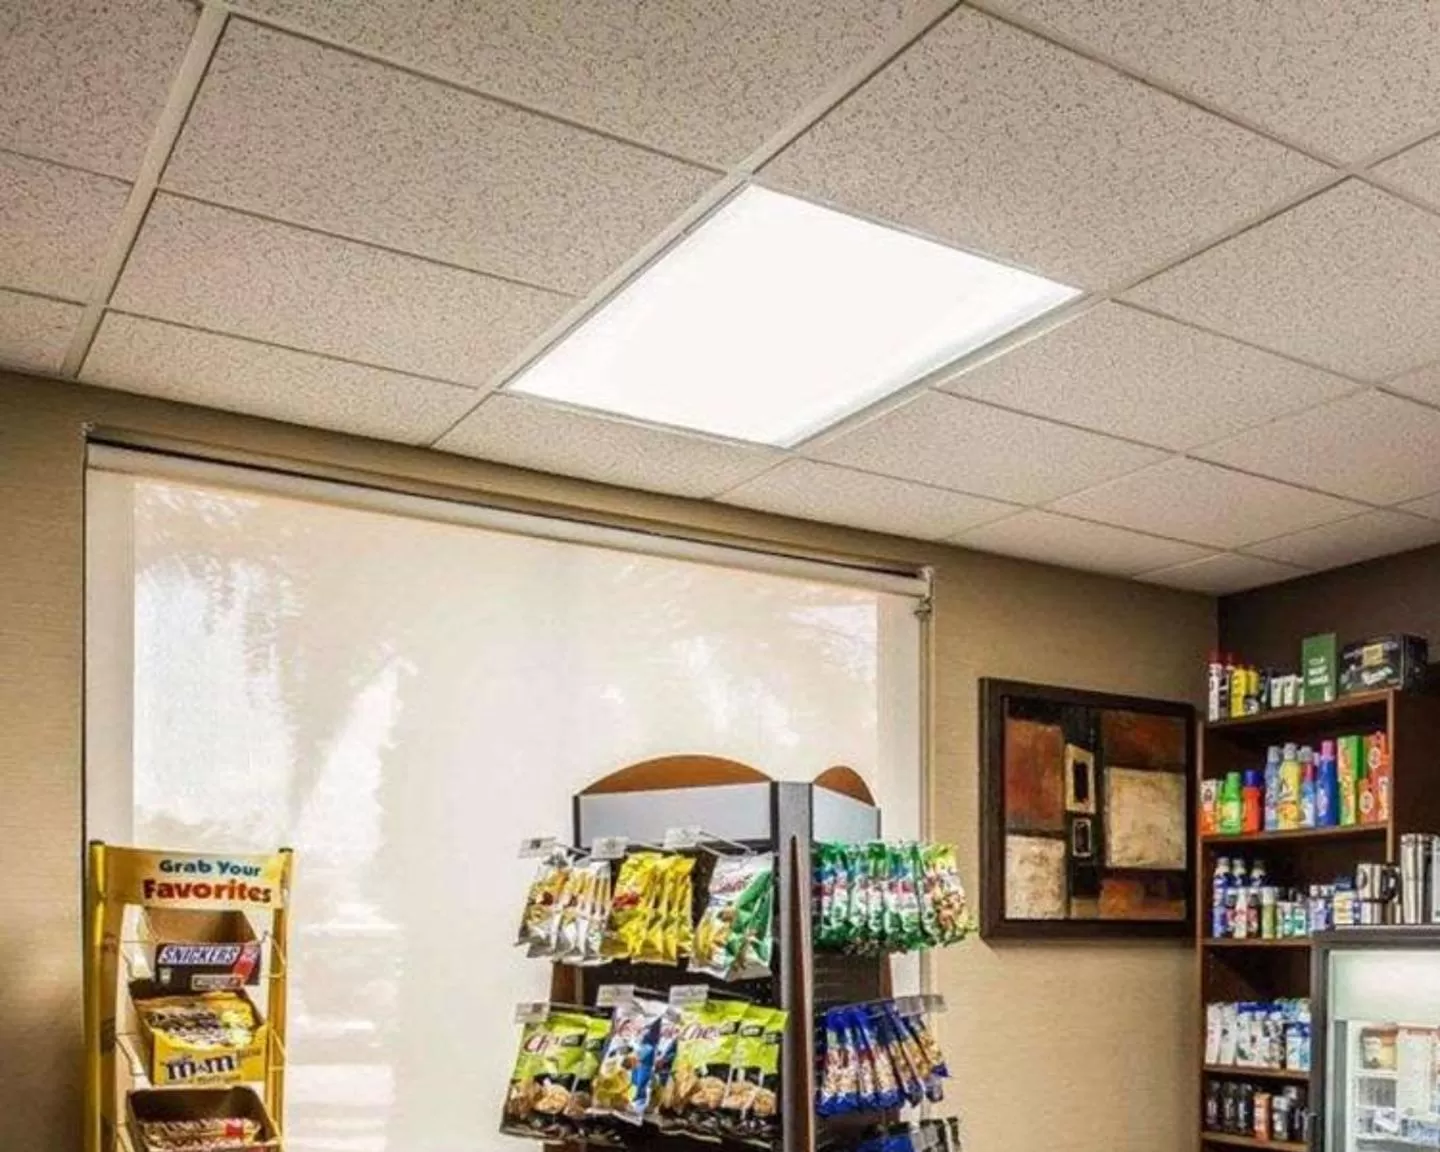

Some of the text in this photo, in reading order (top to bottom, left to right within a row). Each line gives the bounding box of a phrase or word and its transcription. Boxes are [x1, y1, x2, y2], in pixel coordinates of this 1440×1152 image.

[159, 859, 261, 877] Grab Your
[143, 879, 272, 904] Favorites
